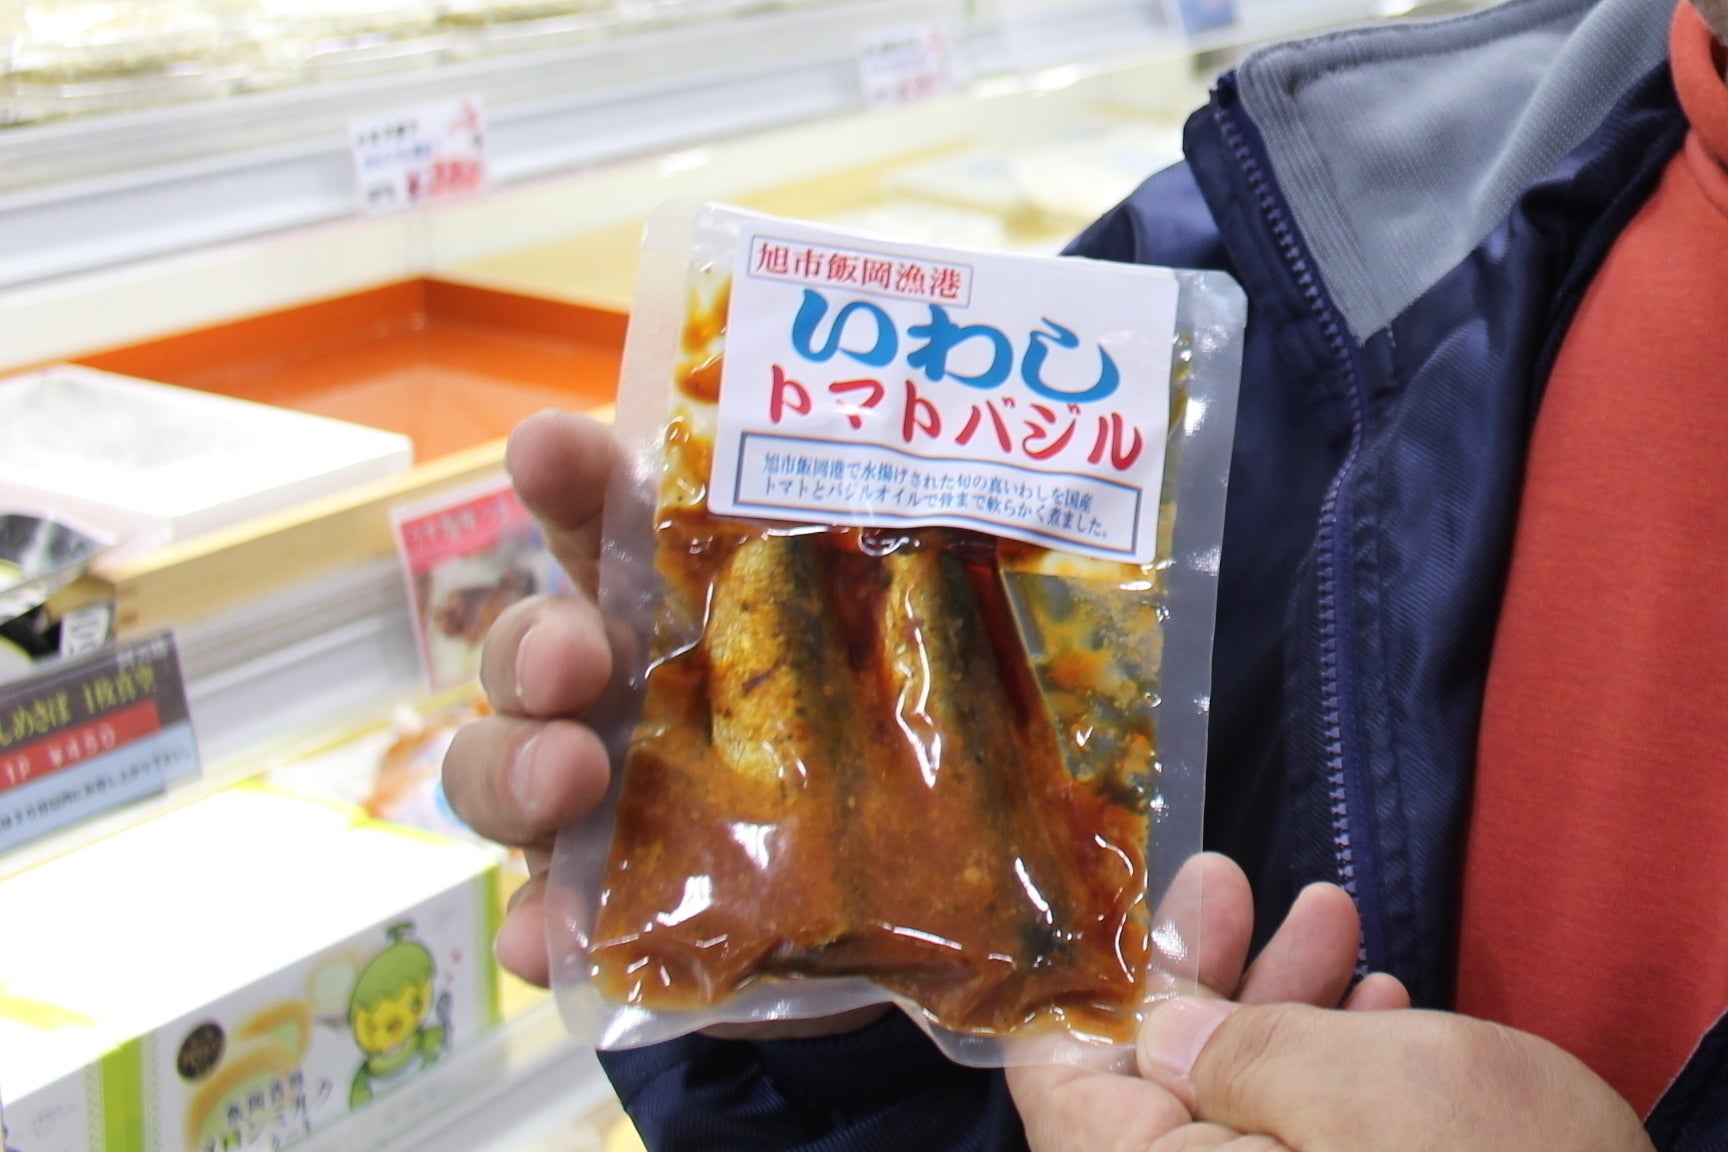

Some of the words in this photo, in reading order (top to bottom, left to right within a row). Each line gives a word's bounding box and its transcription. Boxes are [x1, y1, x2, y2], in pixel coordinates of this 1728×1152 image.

[756, 242, 963, 299] 旭市飯岡漁港
[791, 287, 1120, 404] いわし
[768, 363, 1144, 472] トマトバジル
